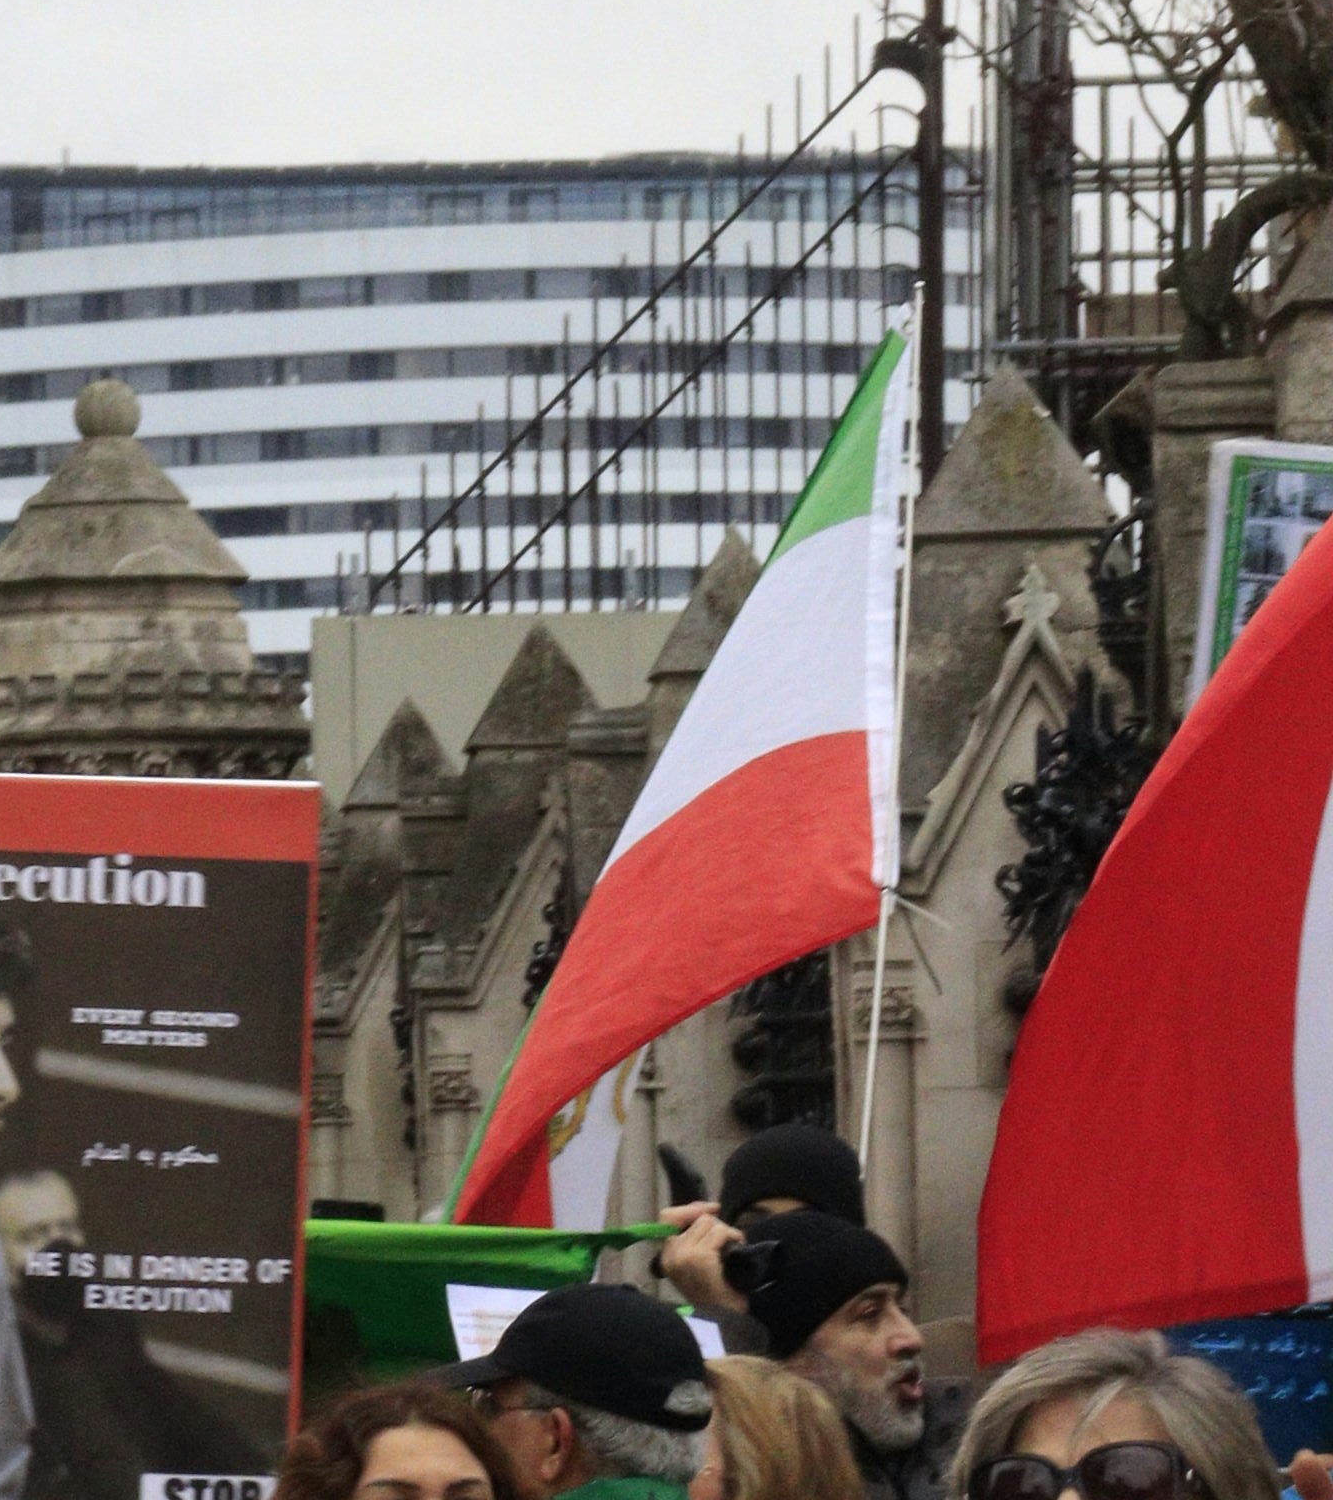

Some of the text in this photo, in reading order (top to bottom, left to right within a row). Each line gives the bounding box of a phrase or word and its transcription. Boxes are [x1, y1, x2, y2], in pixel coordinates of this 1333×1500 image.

[71, 1007, 240, 1027] EVERY SECOND
[101, 1029, 208, 1047] MATTERS
[25, 1252, 292, 1284] HE IS IN DANGER OF
[84, 1284, 232, 1313] EXECUTION
